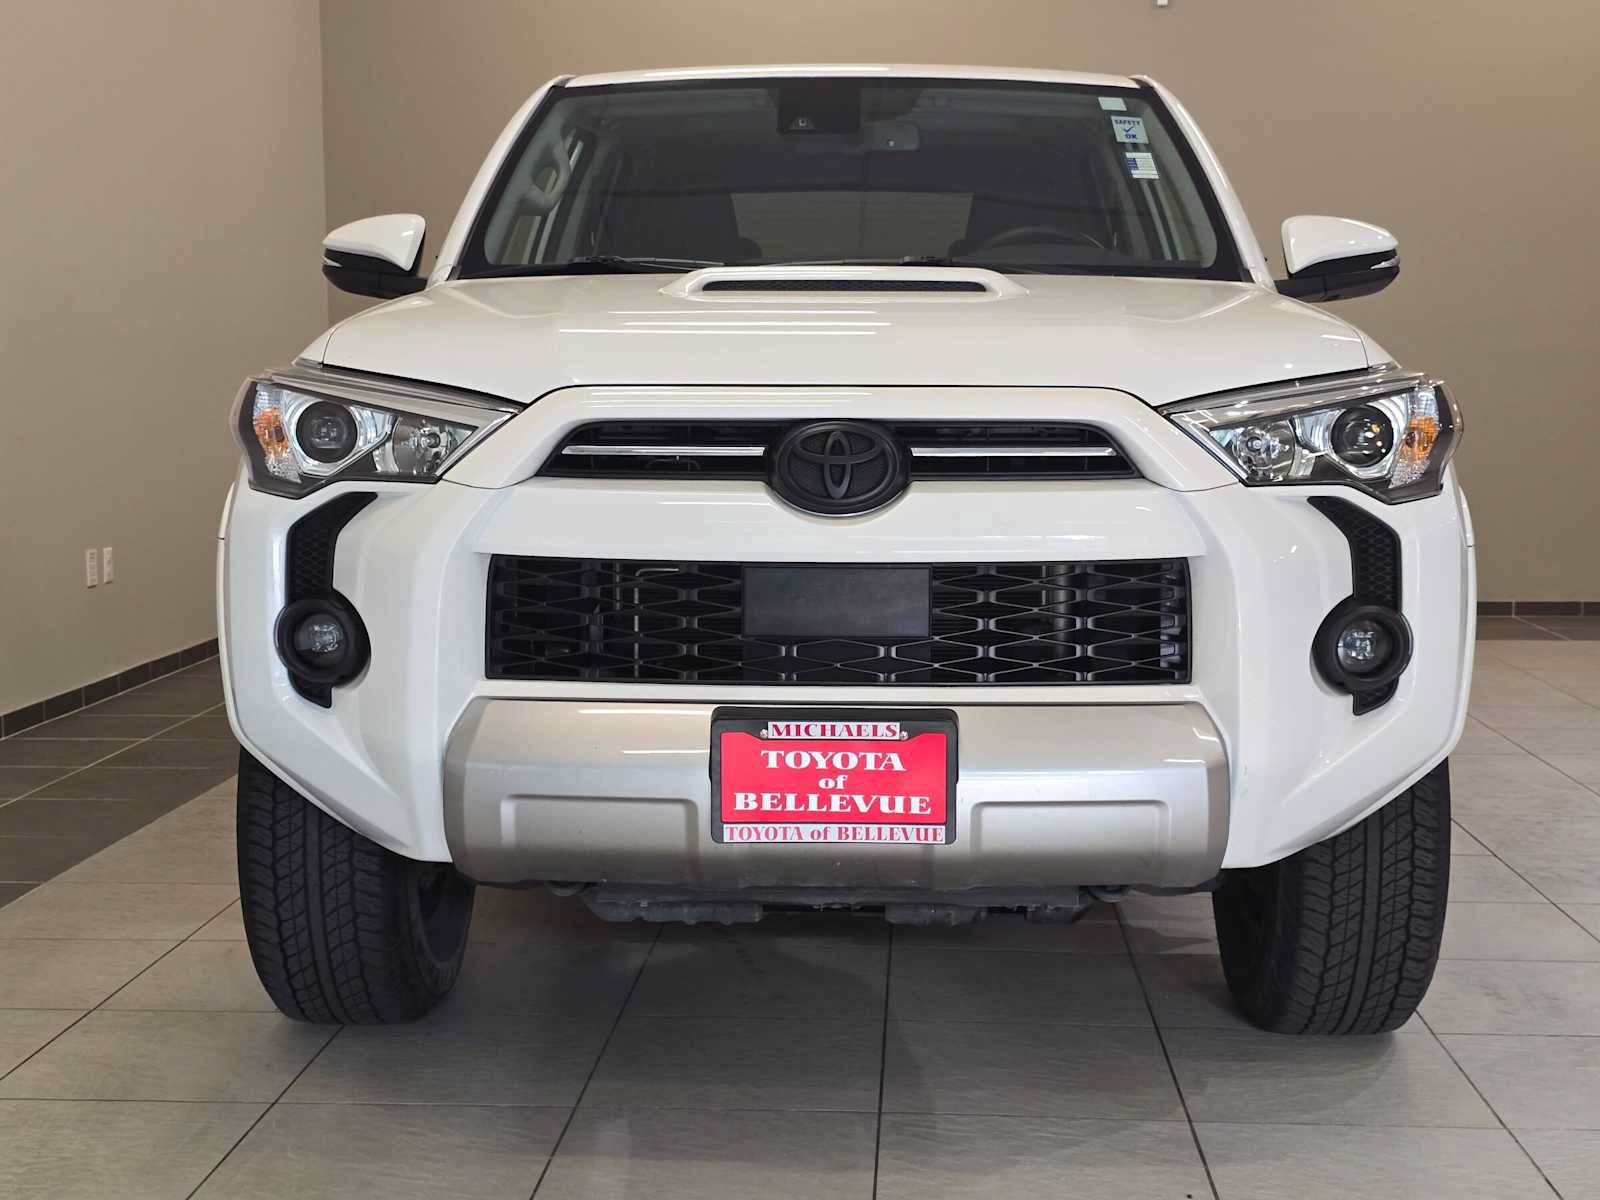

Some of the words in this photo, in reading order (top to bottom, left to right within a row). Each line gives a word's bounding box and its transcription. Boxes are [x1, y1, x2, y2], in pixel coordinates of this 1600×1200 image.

[771, 724, 898, 738] MICHAELS
[760, 750, 906, 771] TOYOTA
[818, 774, 848, 789] of
[734, 792, 932, 814] BELLEVUE
[725, 826, 802, 841] TOYOTA
[810, 825, 832, 841] of
[838, 826, 944, 842] BELLEVUE
